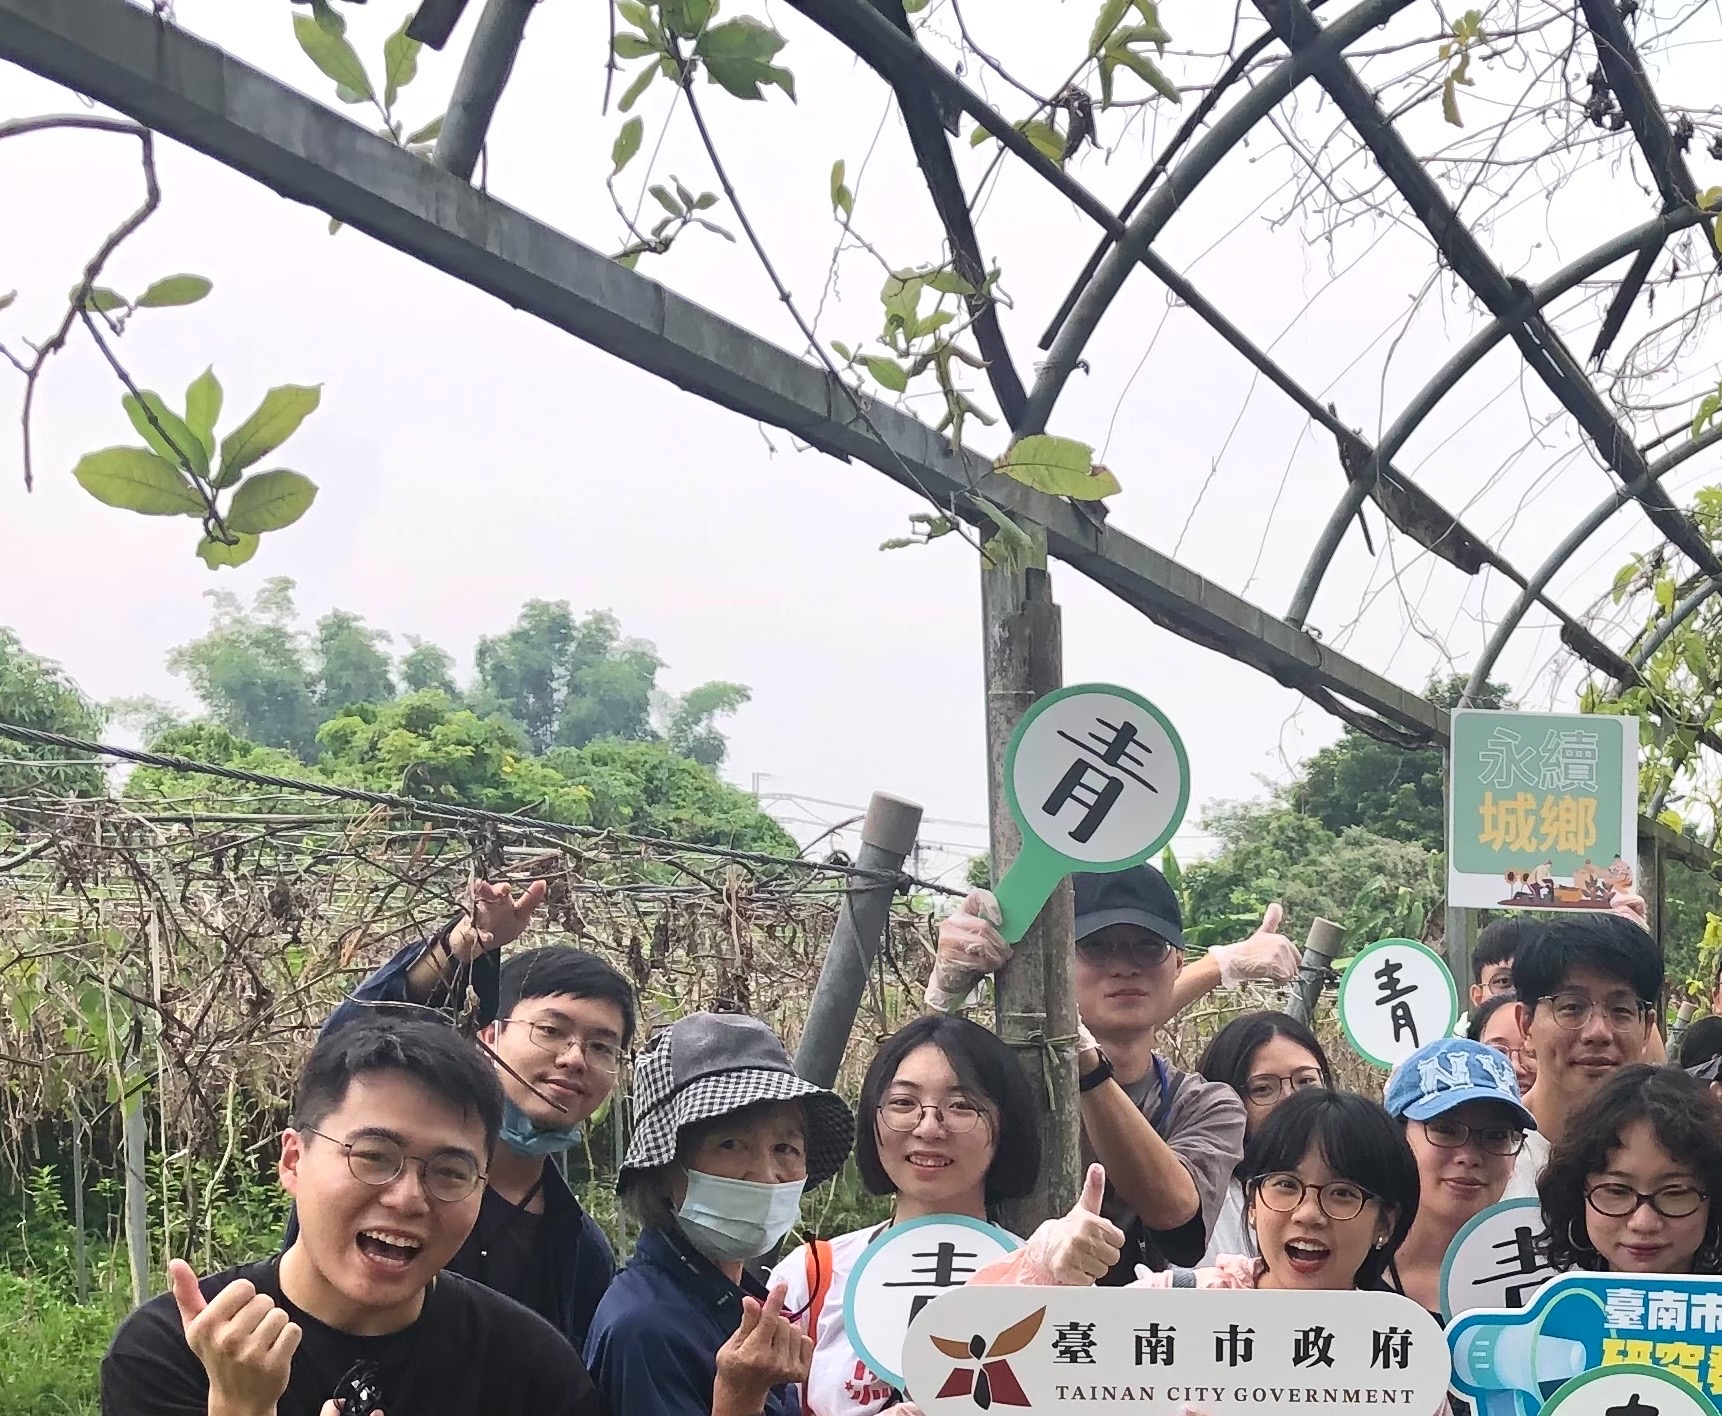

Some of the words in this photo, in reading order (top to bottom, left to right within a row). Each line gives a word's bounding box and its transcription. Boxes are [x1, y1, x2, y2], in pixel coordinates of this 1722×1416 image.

[1042, 716, 1158, 845] 青
[1477, 727, 1599, 793] 永續
[1478, 793, 1597, 857] 城鄉
[1375, 959, 1420, 1049] 青
[1417, 1051, 1517, 1106] NY
[1051, 1321, 1414, 1370] 臺南市政府
[1055, 1385, 1156, 1402] TAINAN
[1167, 1386, 1226, 1402] CITY
[1234, 1387, 1415, 1404] GOVERNMENT
